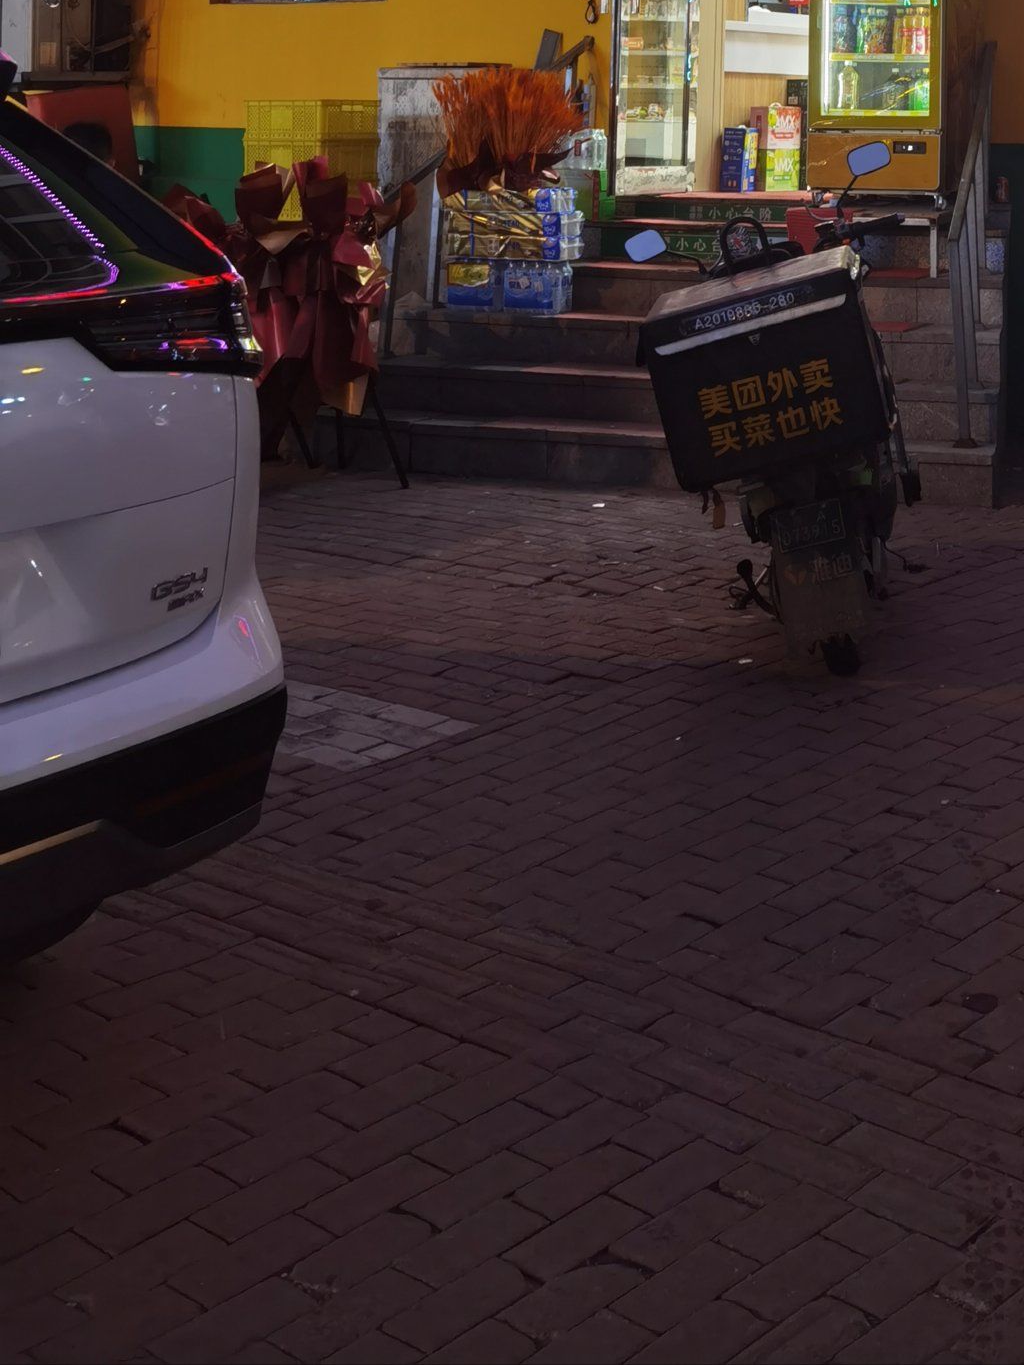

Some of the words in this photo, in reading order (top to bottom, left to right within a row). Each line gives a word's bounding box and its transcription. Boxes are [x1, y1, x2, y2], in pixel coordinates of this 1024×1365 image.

[708, 207, 772, 222] 小心台阶
[697, 358, 834, 420] 美团外卖
[708, 396, 845, 458] 买菜也快
[150, 566, 208, 602] GS4
